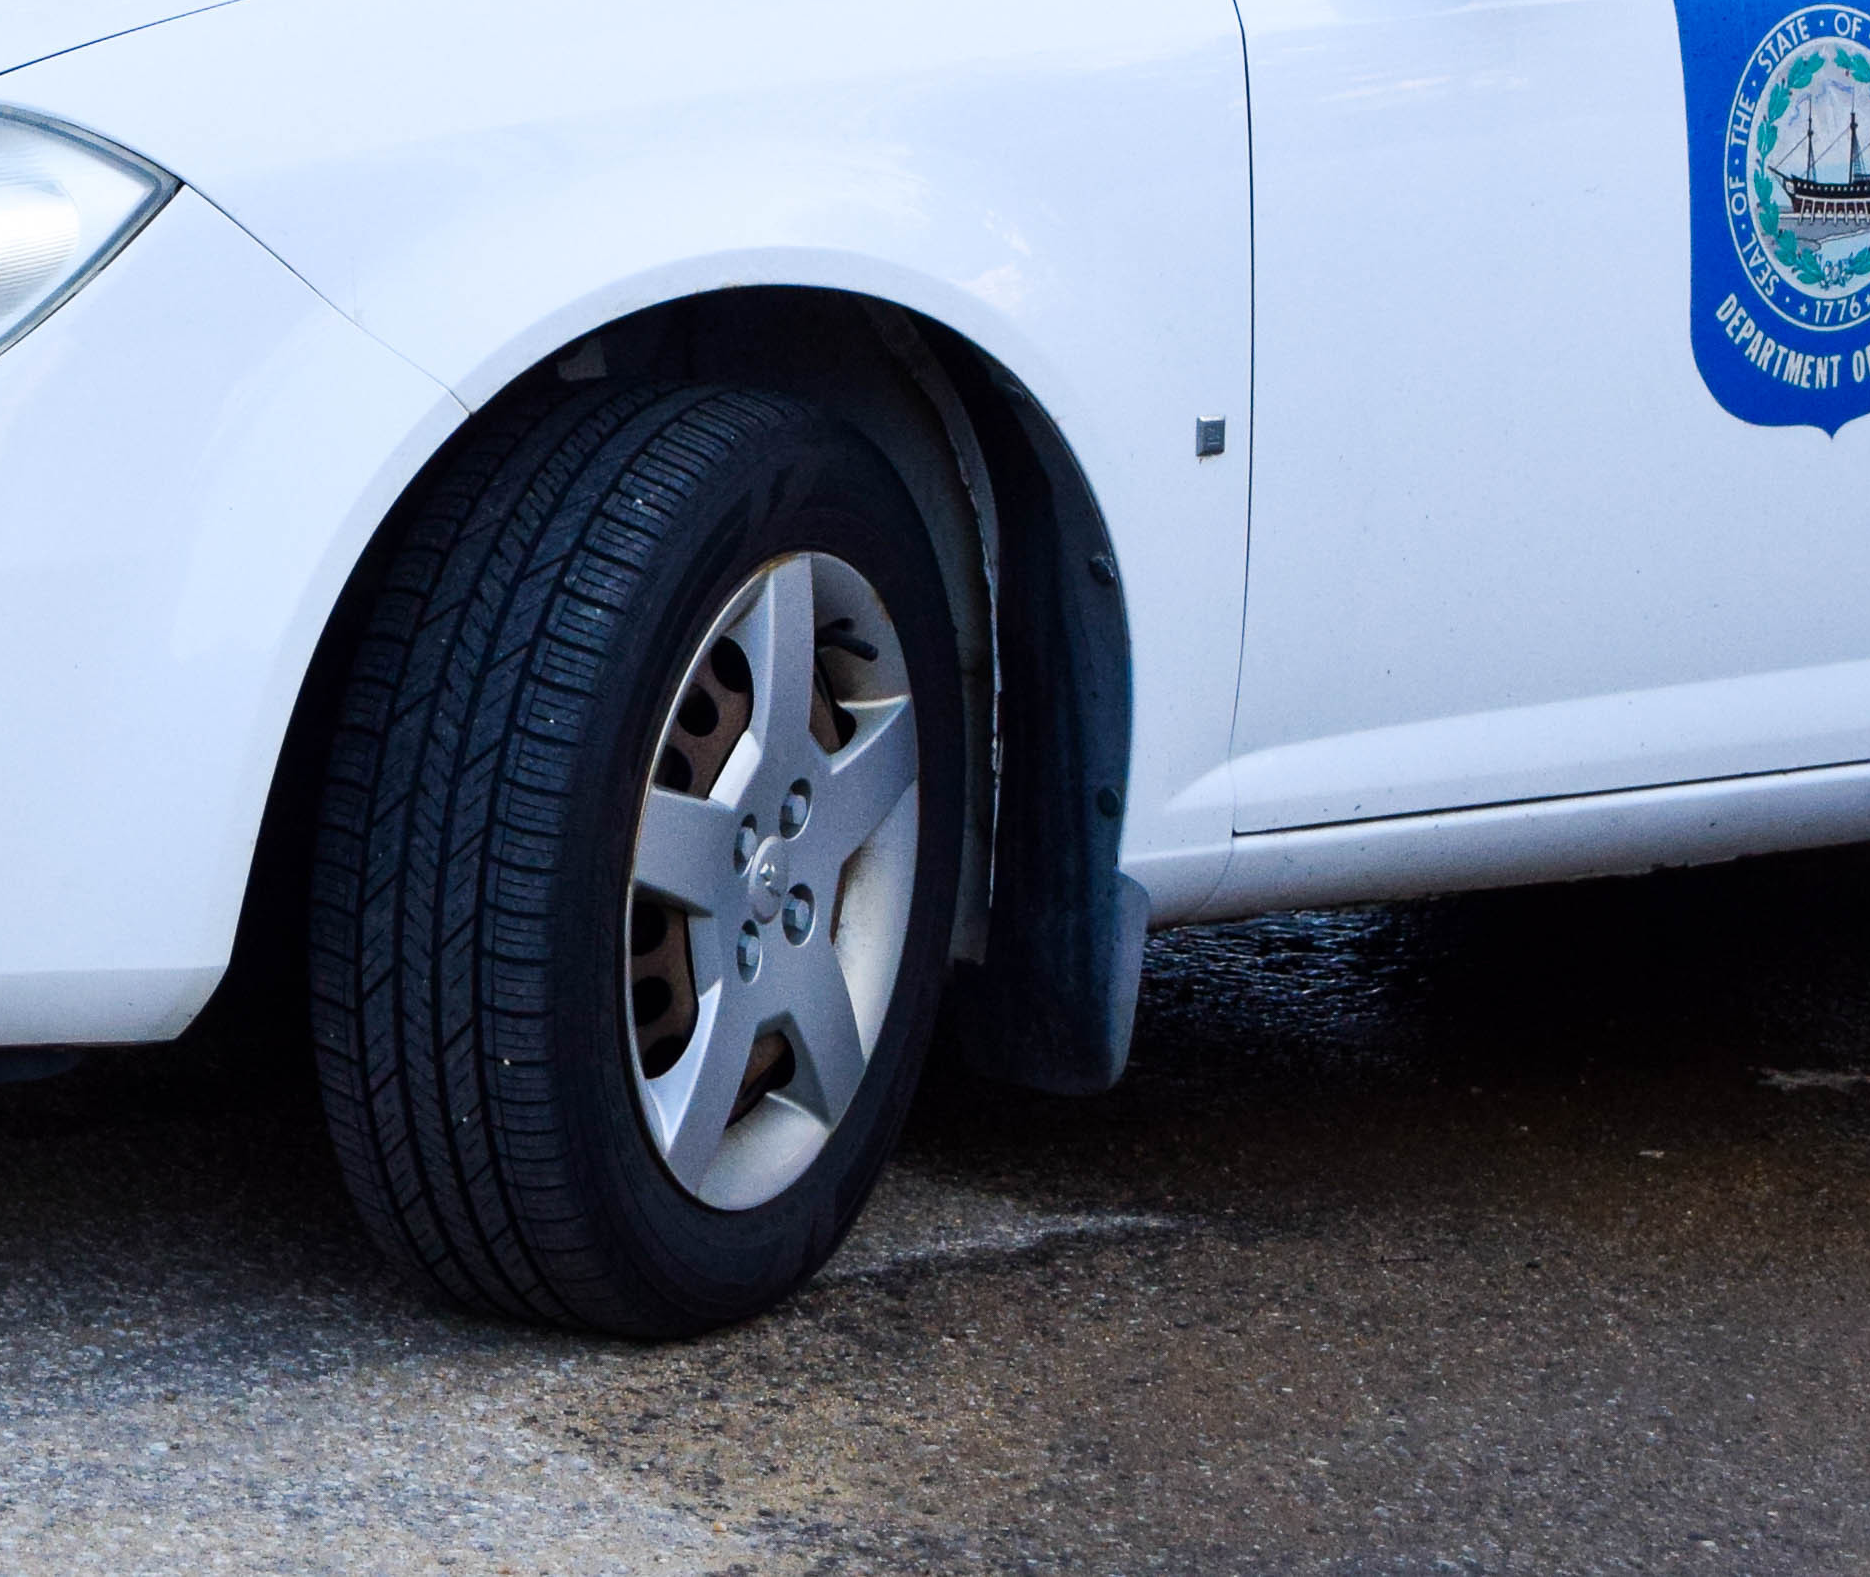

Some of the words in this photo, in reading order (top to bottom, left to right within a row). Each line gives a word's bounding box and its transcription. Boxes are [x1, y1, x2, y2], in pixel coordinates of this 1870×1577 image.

[1758, 16, 1809, 73] STATE
[1833, 11, 1863, 38] OF
[1731, 94, 1756, 147] THE
[1730, 172, 1748, 215] OF
[1742, 232, 1780, 295] SEAL
[1813, 298, 1862, 323] 1776
[1715, 292, 1840, 390] DEPARTMENT
